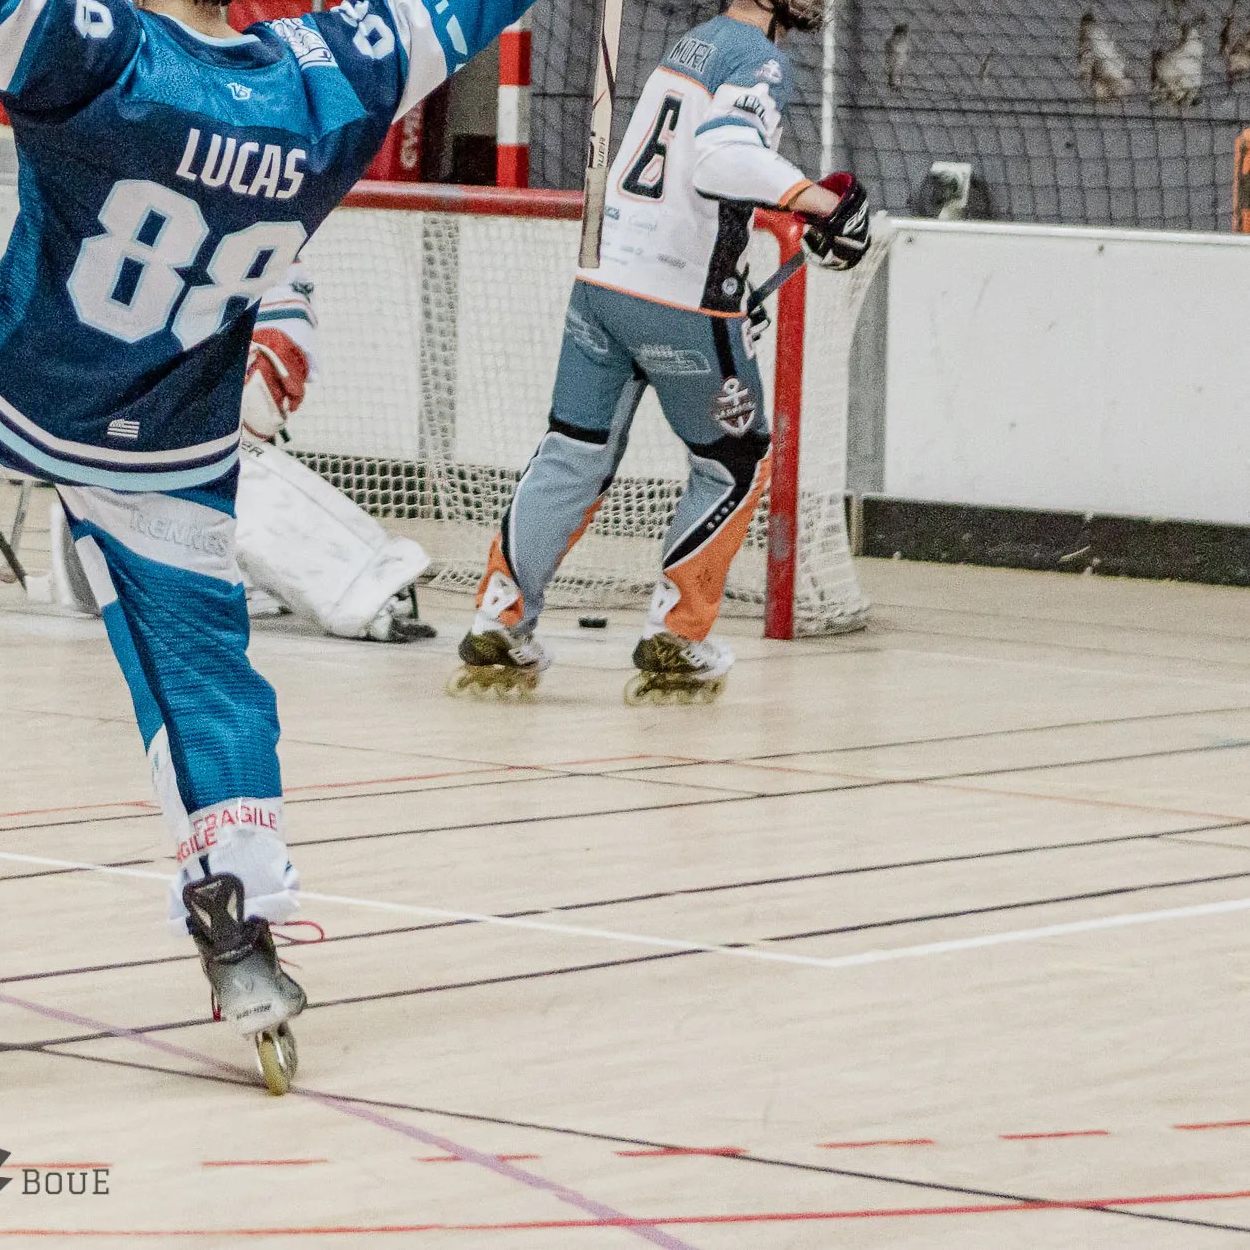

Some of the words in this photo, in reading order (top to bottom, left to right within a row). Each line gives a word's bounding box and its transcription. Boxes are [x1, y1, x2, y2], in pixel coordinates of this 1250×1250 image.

[176, 128, 306, 200] LUCAS
[617, 89, 686, 203] 6
[66, 179, 308, 351] 88
[193, 804, 278, 832] FRAGILE
